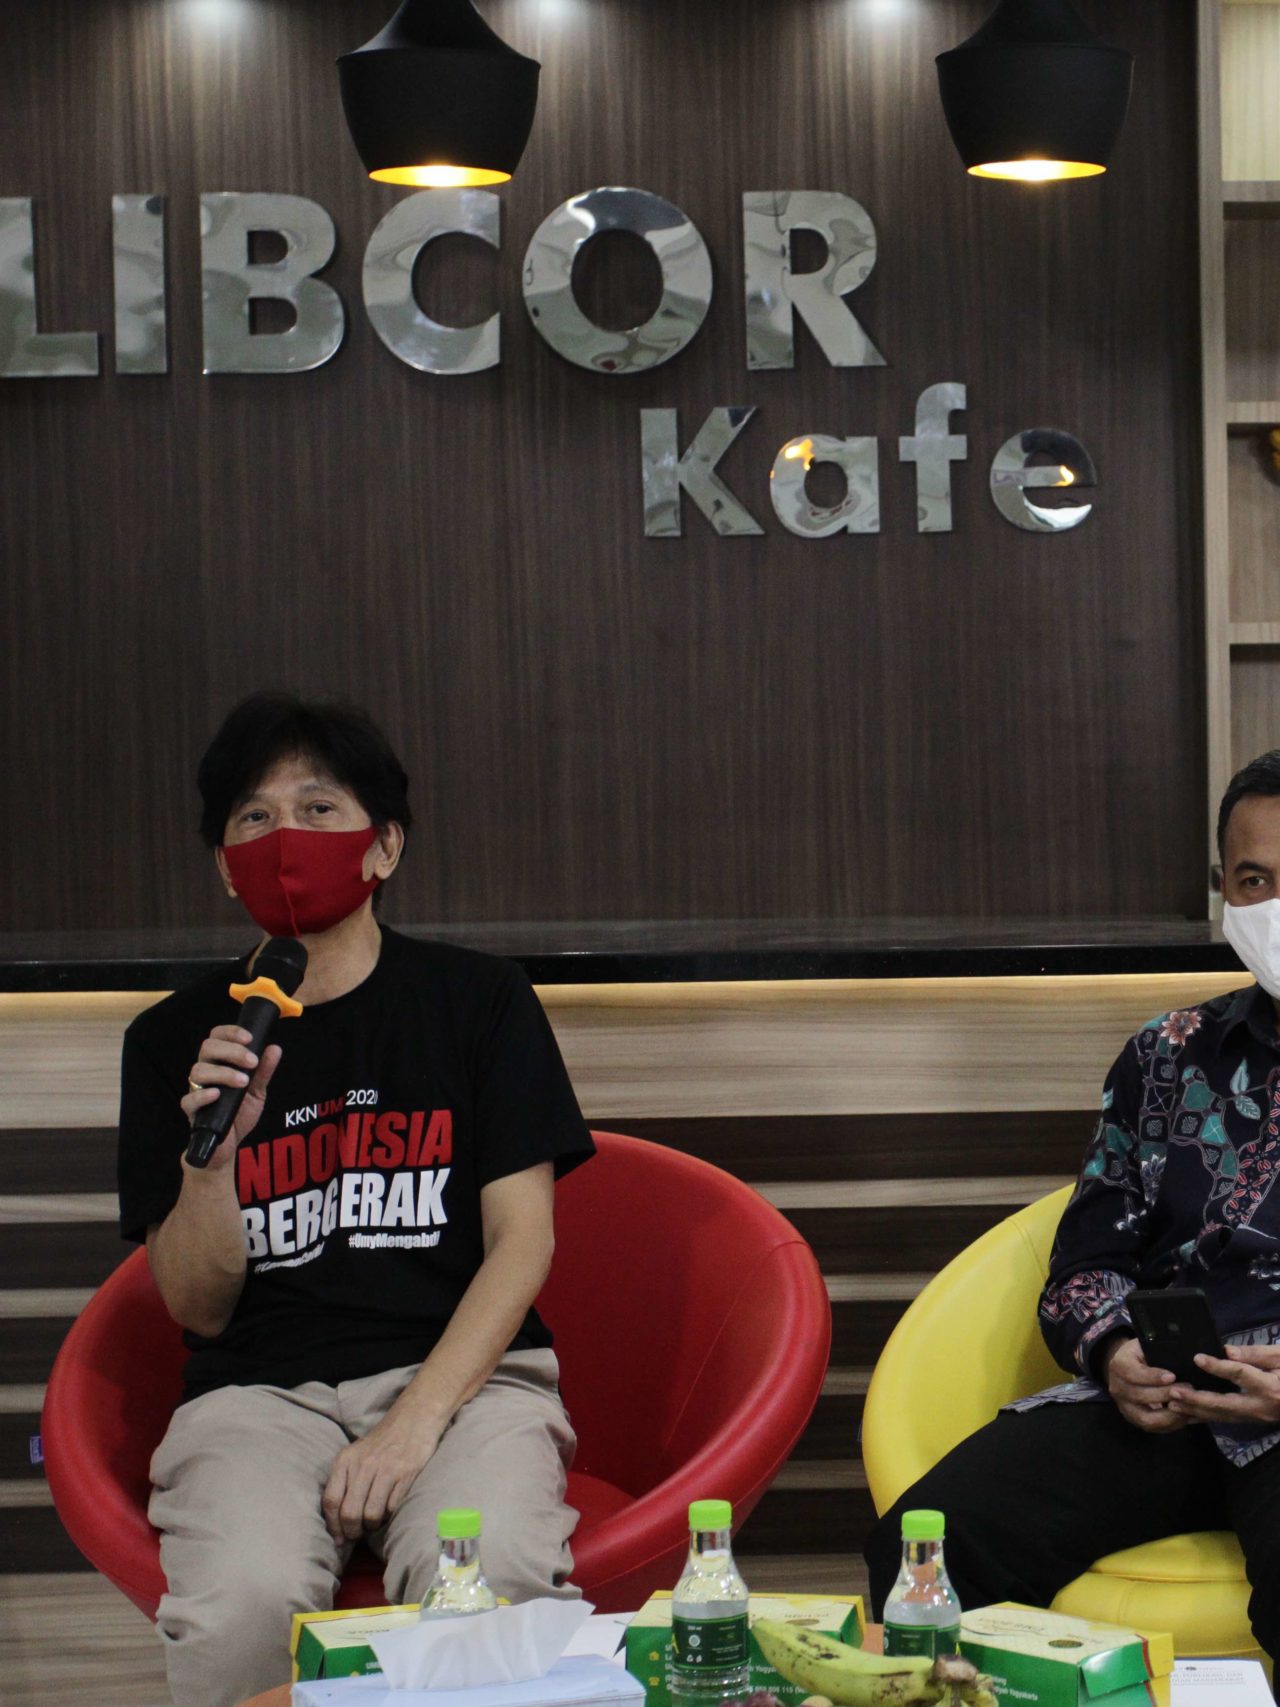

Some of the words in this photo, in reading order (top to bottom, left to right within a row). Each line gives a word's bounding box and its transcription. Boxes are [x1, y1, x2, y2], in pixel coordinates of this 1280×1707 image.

[0, 186, 888, 376] LIBCOR
[640, 382, 1097, 538] Kafe
[240, 1167, 450, 1258] BERGERAK
